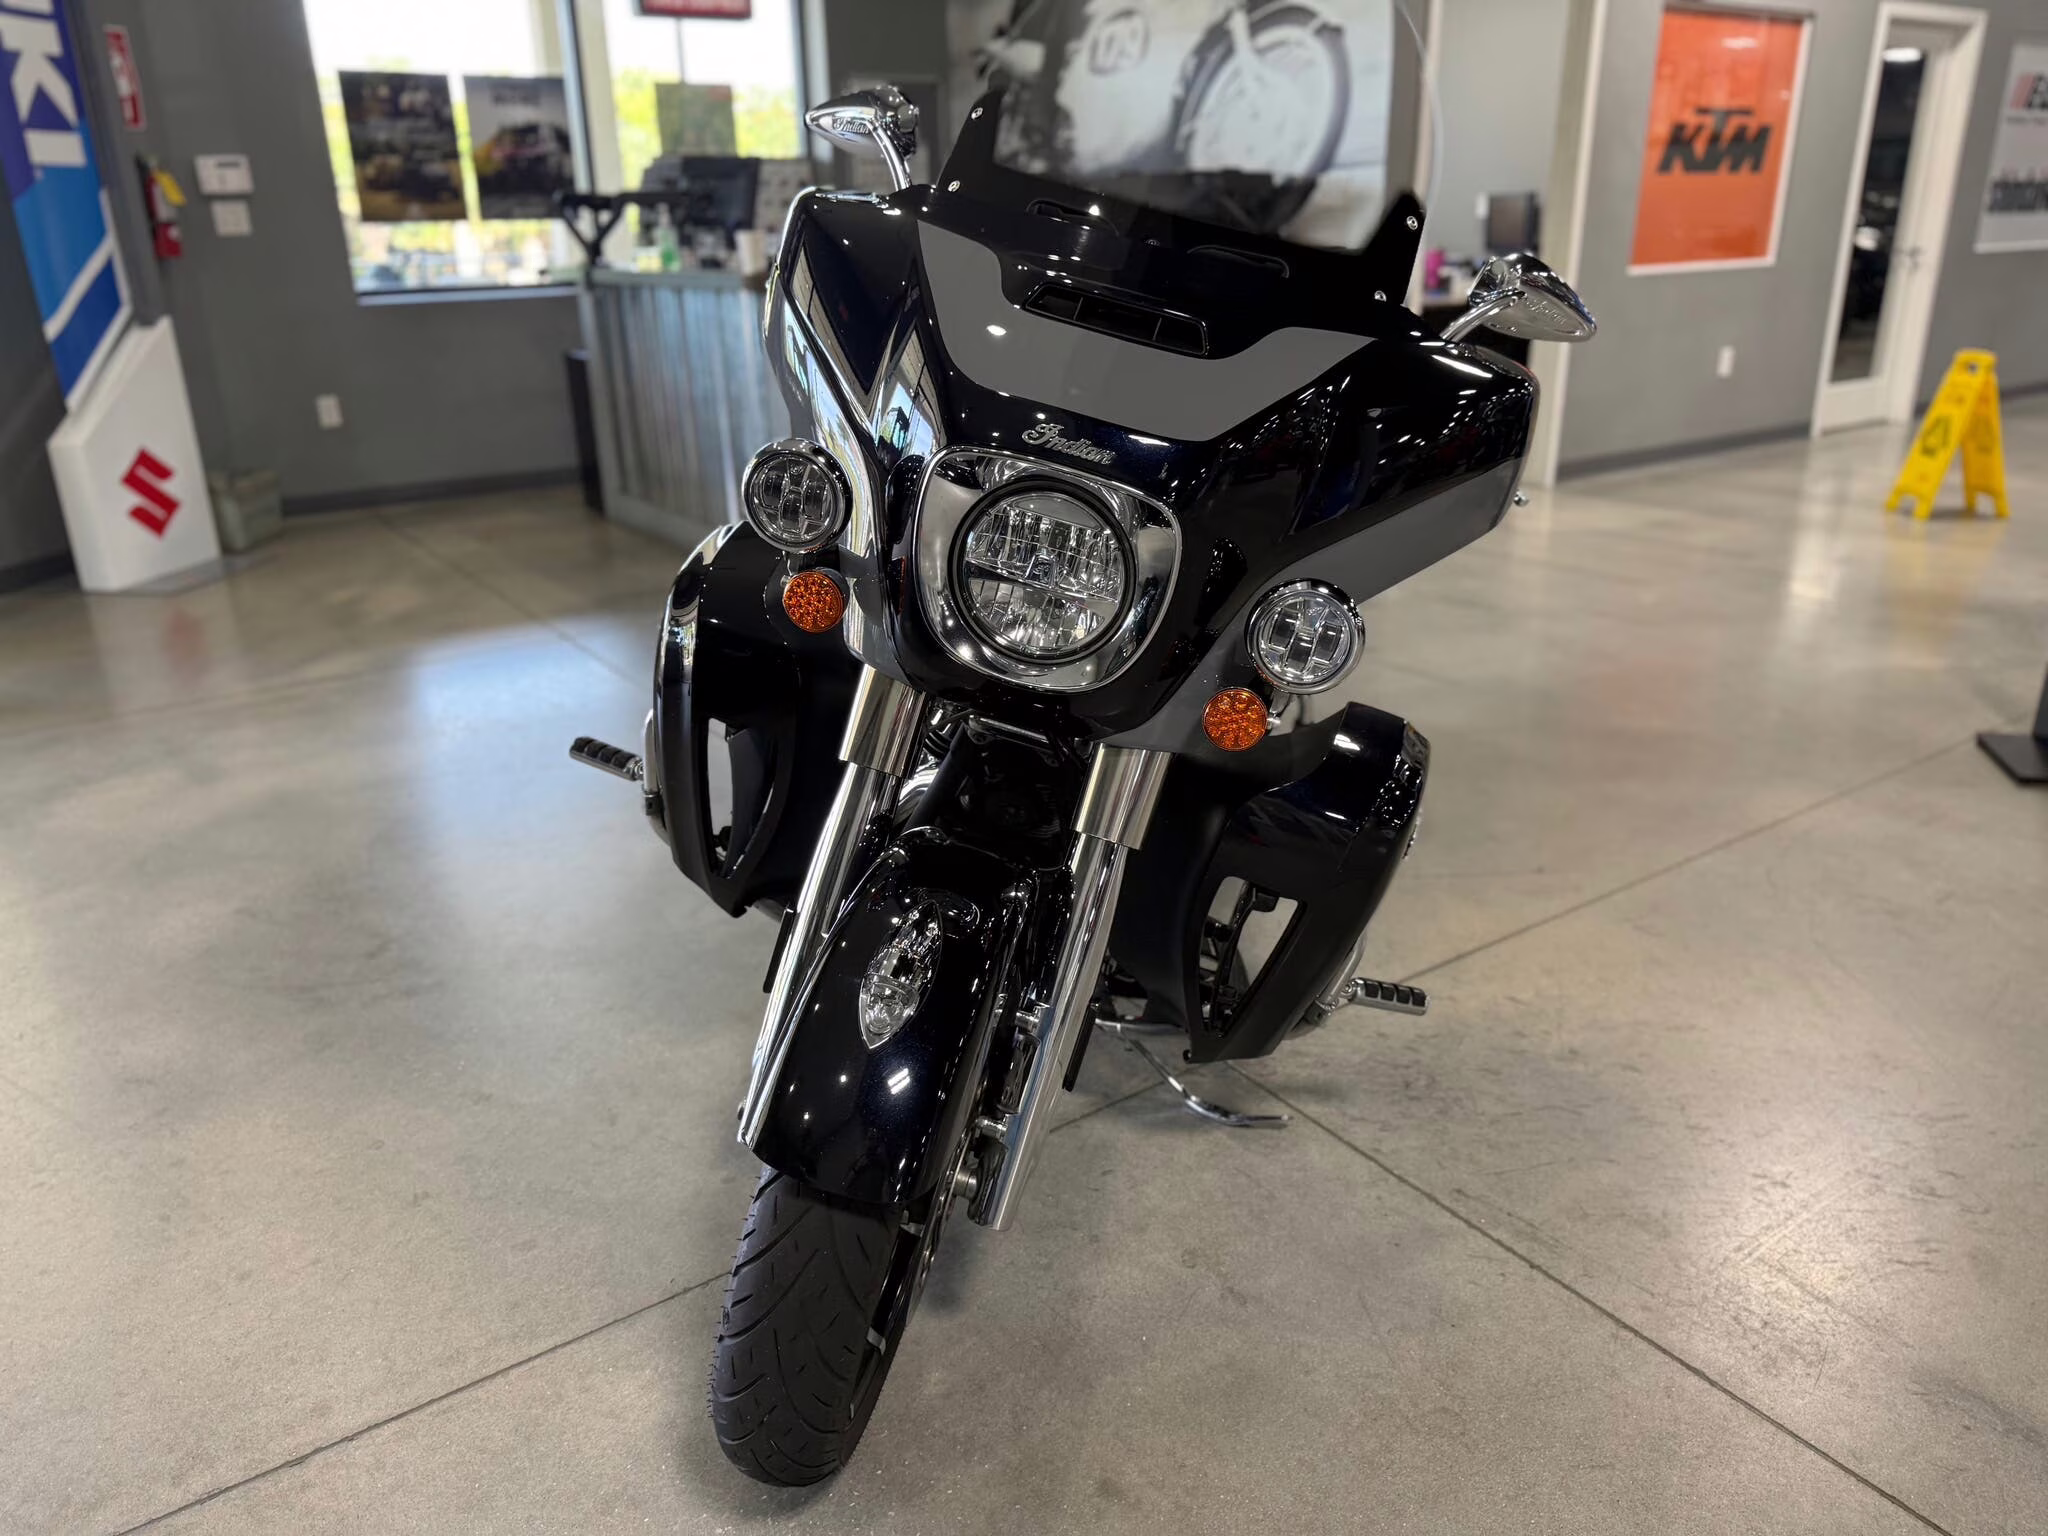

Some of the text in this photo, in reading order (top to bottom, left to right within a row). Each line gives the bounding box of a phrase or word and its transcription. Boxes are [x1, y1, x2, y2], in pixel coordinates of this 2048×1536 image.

[0, 0, 87, 168] KI
[834, 117, 870, 135] Indian
[1658, 107, 1771, 173] KTM
[1022, 424, 1116, 464] Indian
